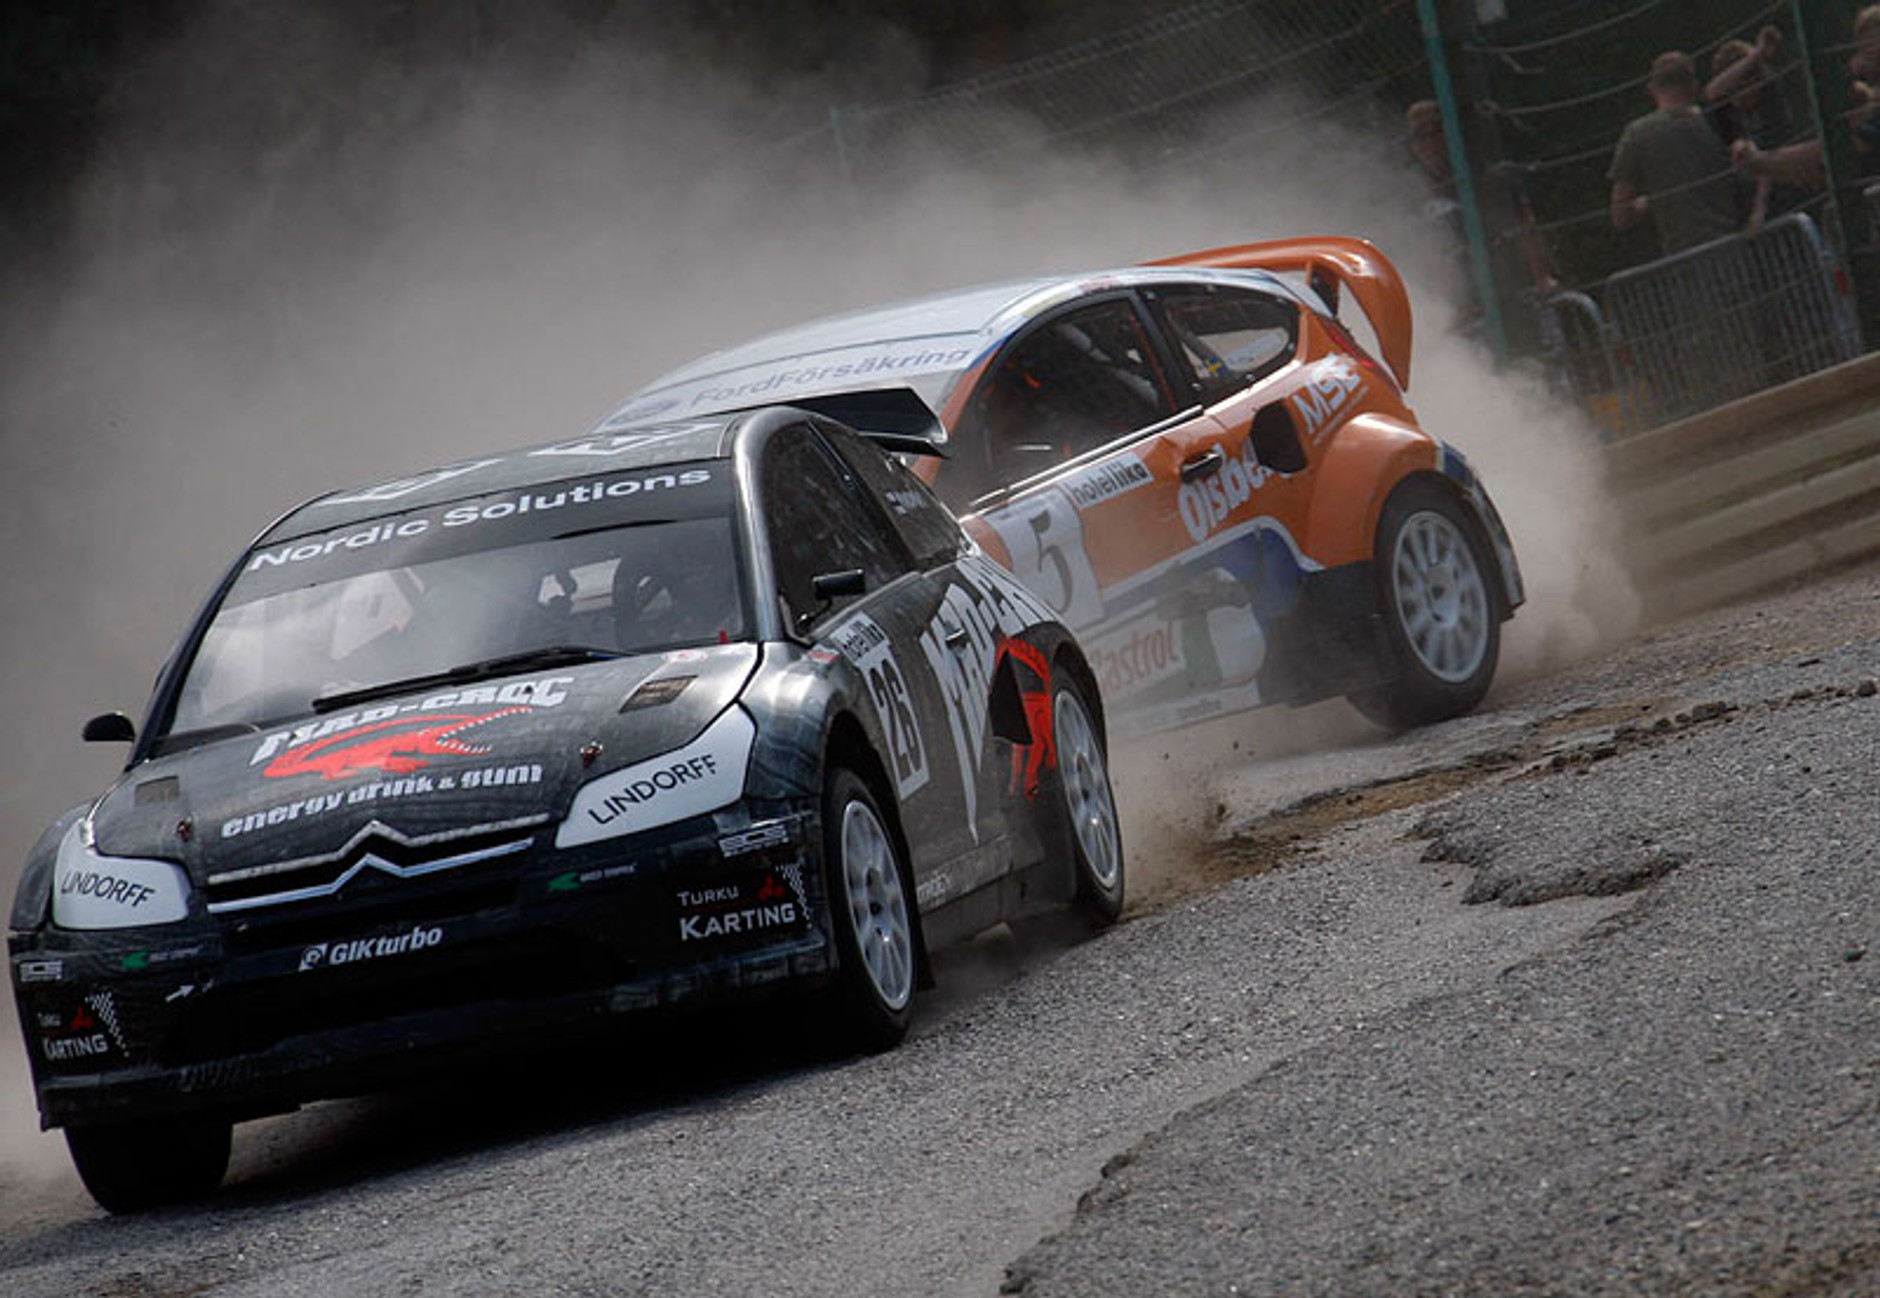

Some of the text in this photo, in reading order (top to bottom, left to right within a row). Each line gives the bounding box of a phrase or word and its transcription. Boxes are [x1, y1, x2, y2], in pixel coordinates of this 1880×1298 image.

[249, 517, 429, 571] Nordic
[443, 467, 712, 526] Solutions
[1028, 508, 1073, 615] 5
[222, 764, 543, 838] energy drink & gum
[588, 753, 718, 826] LINDORFF
[60, 870, 155, 908] LINDORFF
[677, 885, 739, 906] TURKU
[330, 925, 443, 965] GIKturbo
[679, 902, 796, 941] KARTING
